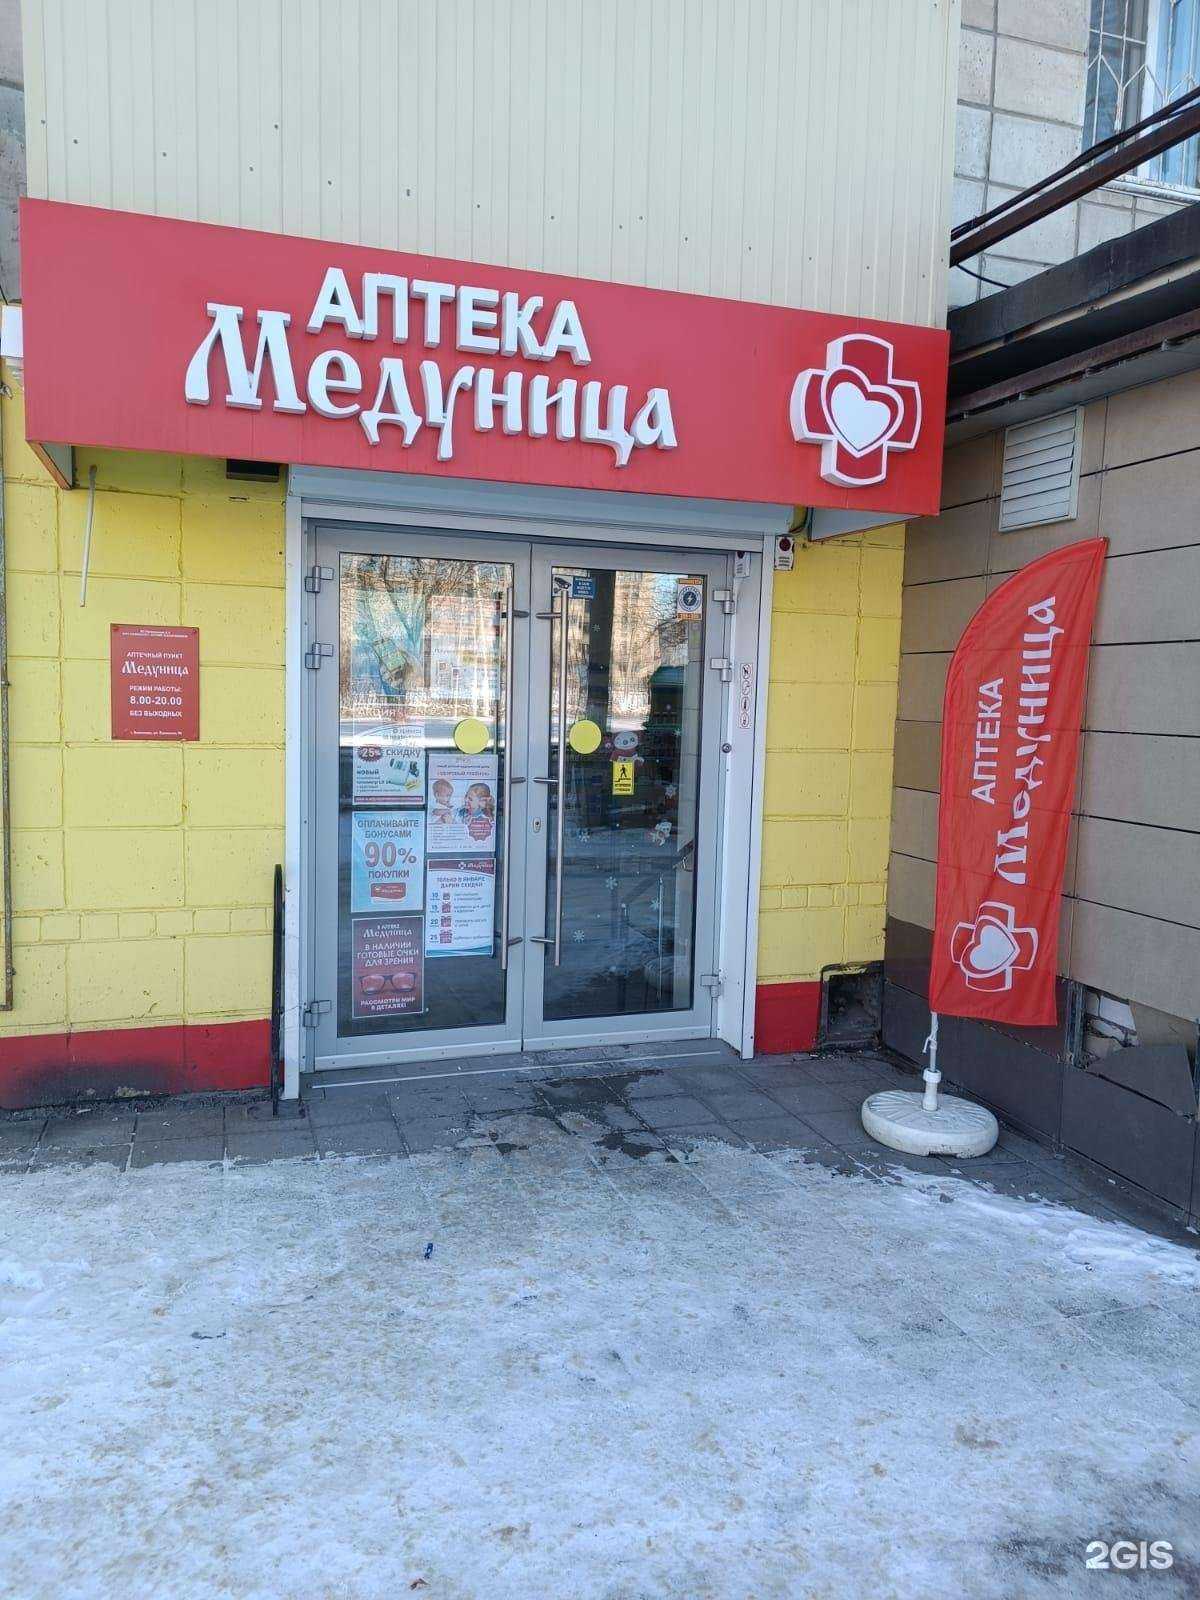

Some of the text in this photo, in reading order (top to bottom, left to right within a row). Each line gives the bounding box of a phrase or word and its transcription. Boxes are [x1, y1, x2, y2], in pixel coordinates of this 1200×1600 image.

[307, 266, 592, 366] АПТЕКА
[184, 302, 678, 468] Медуница
[121, 660, 189, 678] Медуница
[129, 695, 182, 706] 8.00-20.00
[144, 710, 182, 718] ВЫХОДНЫХ
[971, 677, 1004, 804] АПТЕКА
[993, 596, 1064, 885] Медуница
[357, 818, 419, 828] ОПЛАЧИВАЙТЕ
[365, 830, 412, 838] БОНУСАМИ
[364, 842, 417, 867] 90%
[369, 870, 409, 878] ПОКУПКИ
[373, 942, 411, 950] НАЛИЧИИ
[383, 957, 414, 965] ЗРЕНИЯ
